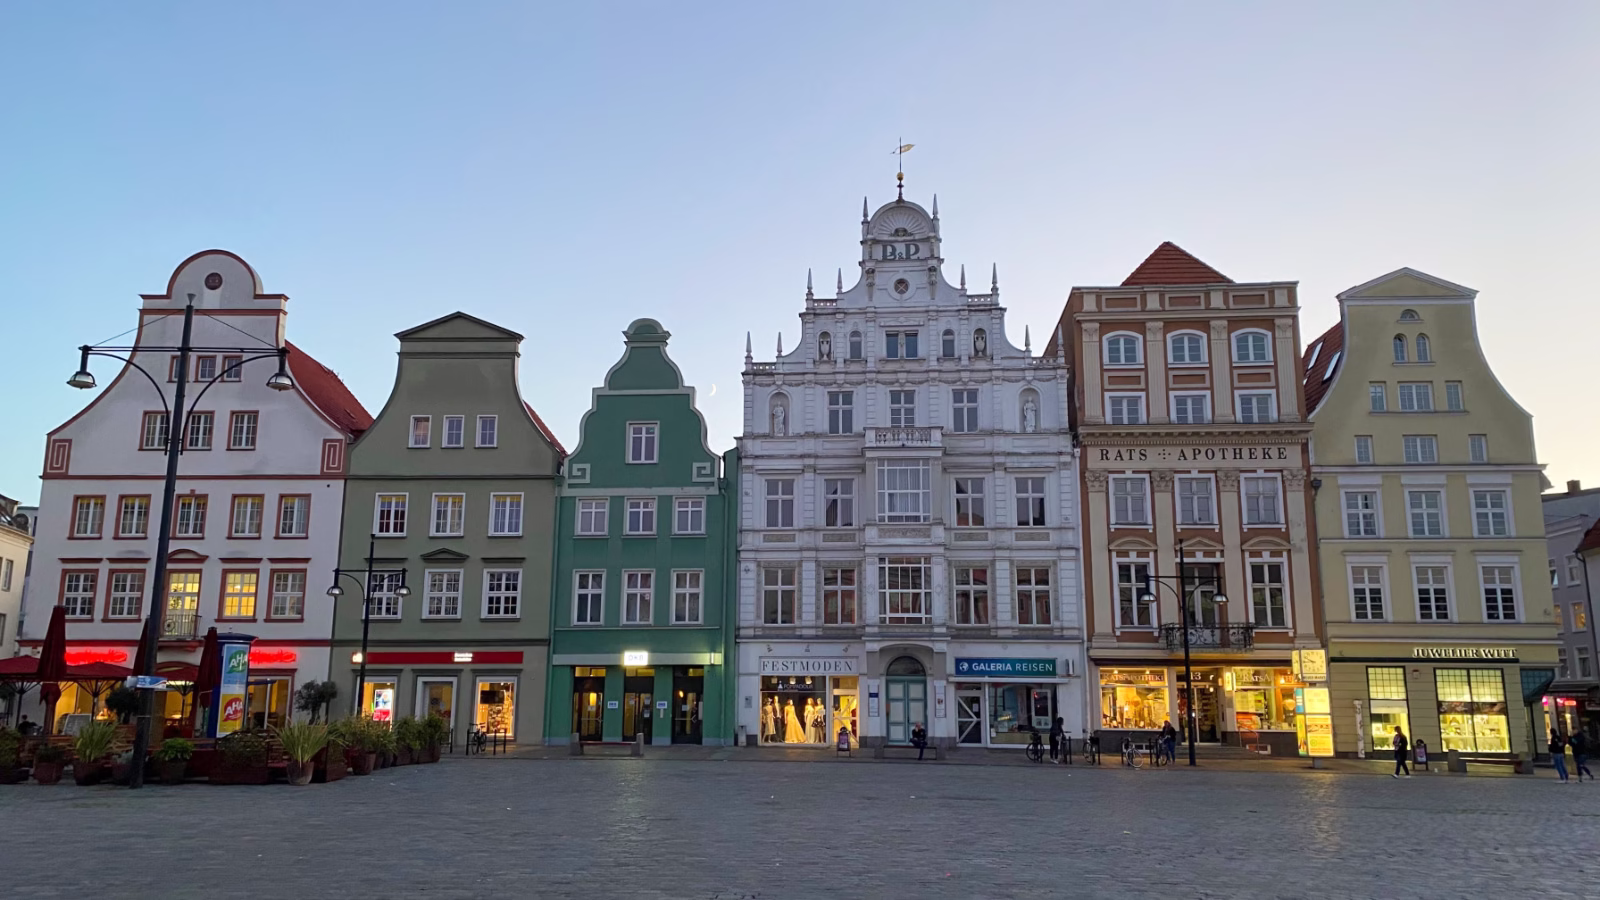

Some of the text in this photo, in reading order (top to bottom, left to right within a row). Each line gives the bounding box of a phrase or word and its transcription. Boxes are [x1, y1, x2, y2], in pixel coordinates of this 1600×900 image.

[1100, 447, 1287, 461] RATS APOTHEKE
[1412, 647, 1518, 659] JUWELIER WITT
[762, 660, 853, 672] FESTMODEN
[972, 663, 1053, 672] GALERIA REISEN
